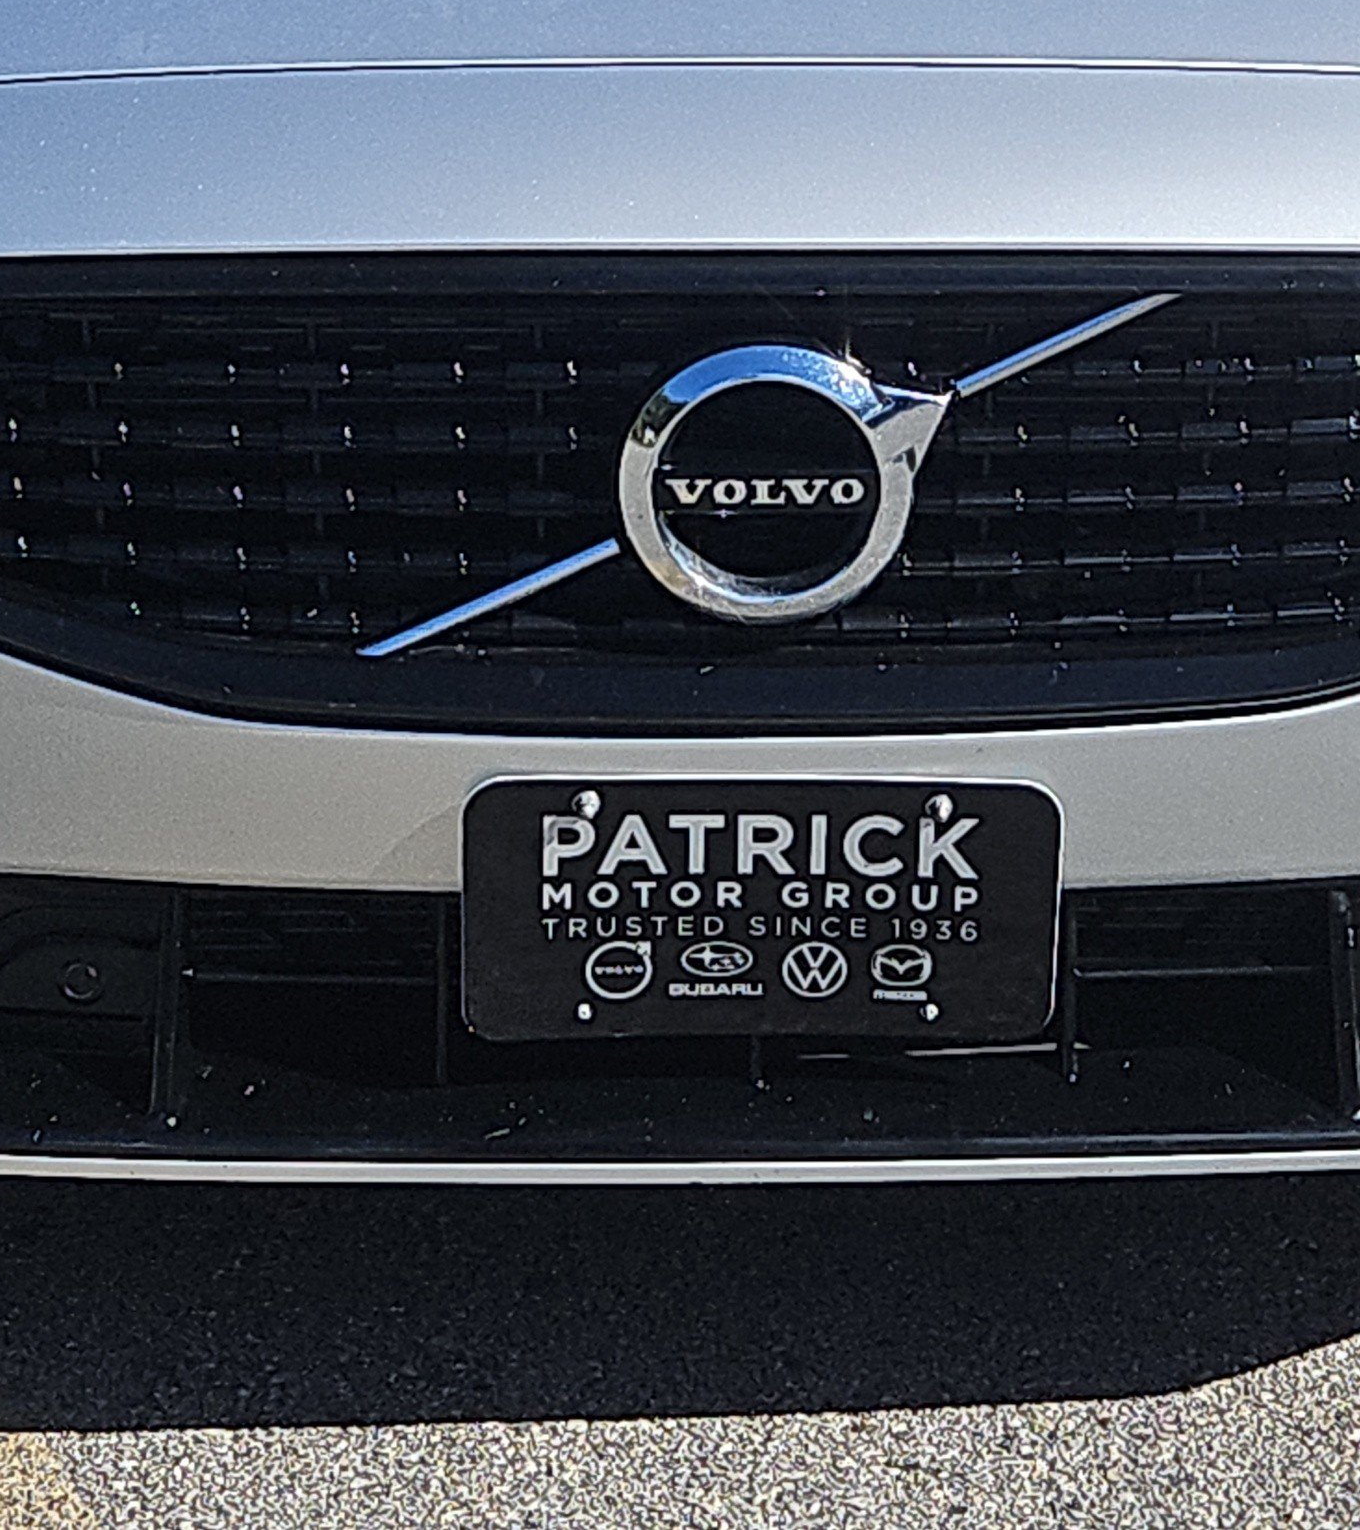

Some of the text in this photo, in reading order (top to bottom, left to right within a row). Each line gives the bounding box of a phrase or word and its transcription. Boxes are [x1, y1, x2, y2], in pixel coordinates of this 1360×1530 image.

[665, 478, 865, 505] VOLVO
[542, 813, 980, 880] PATRICK
[542, 881, 979, 912] MOTOR GROUP
[542, 916, 978, 941] TRUSTED SINCE 1936
[668, 983, 764, 997] SUBARU
